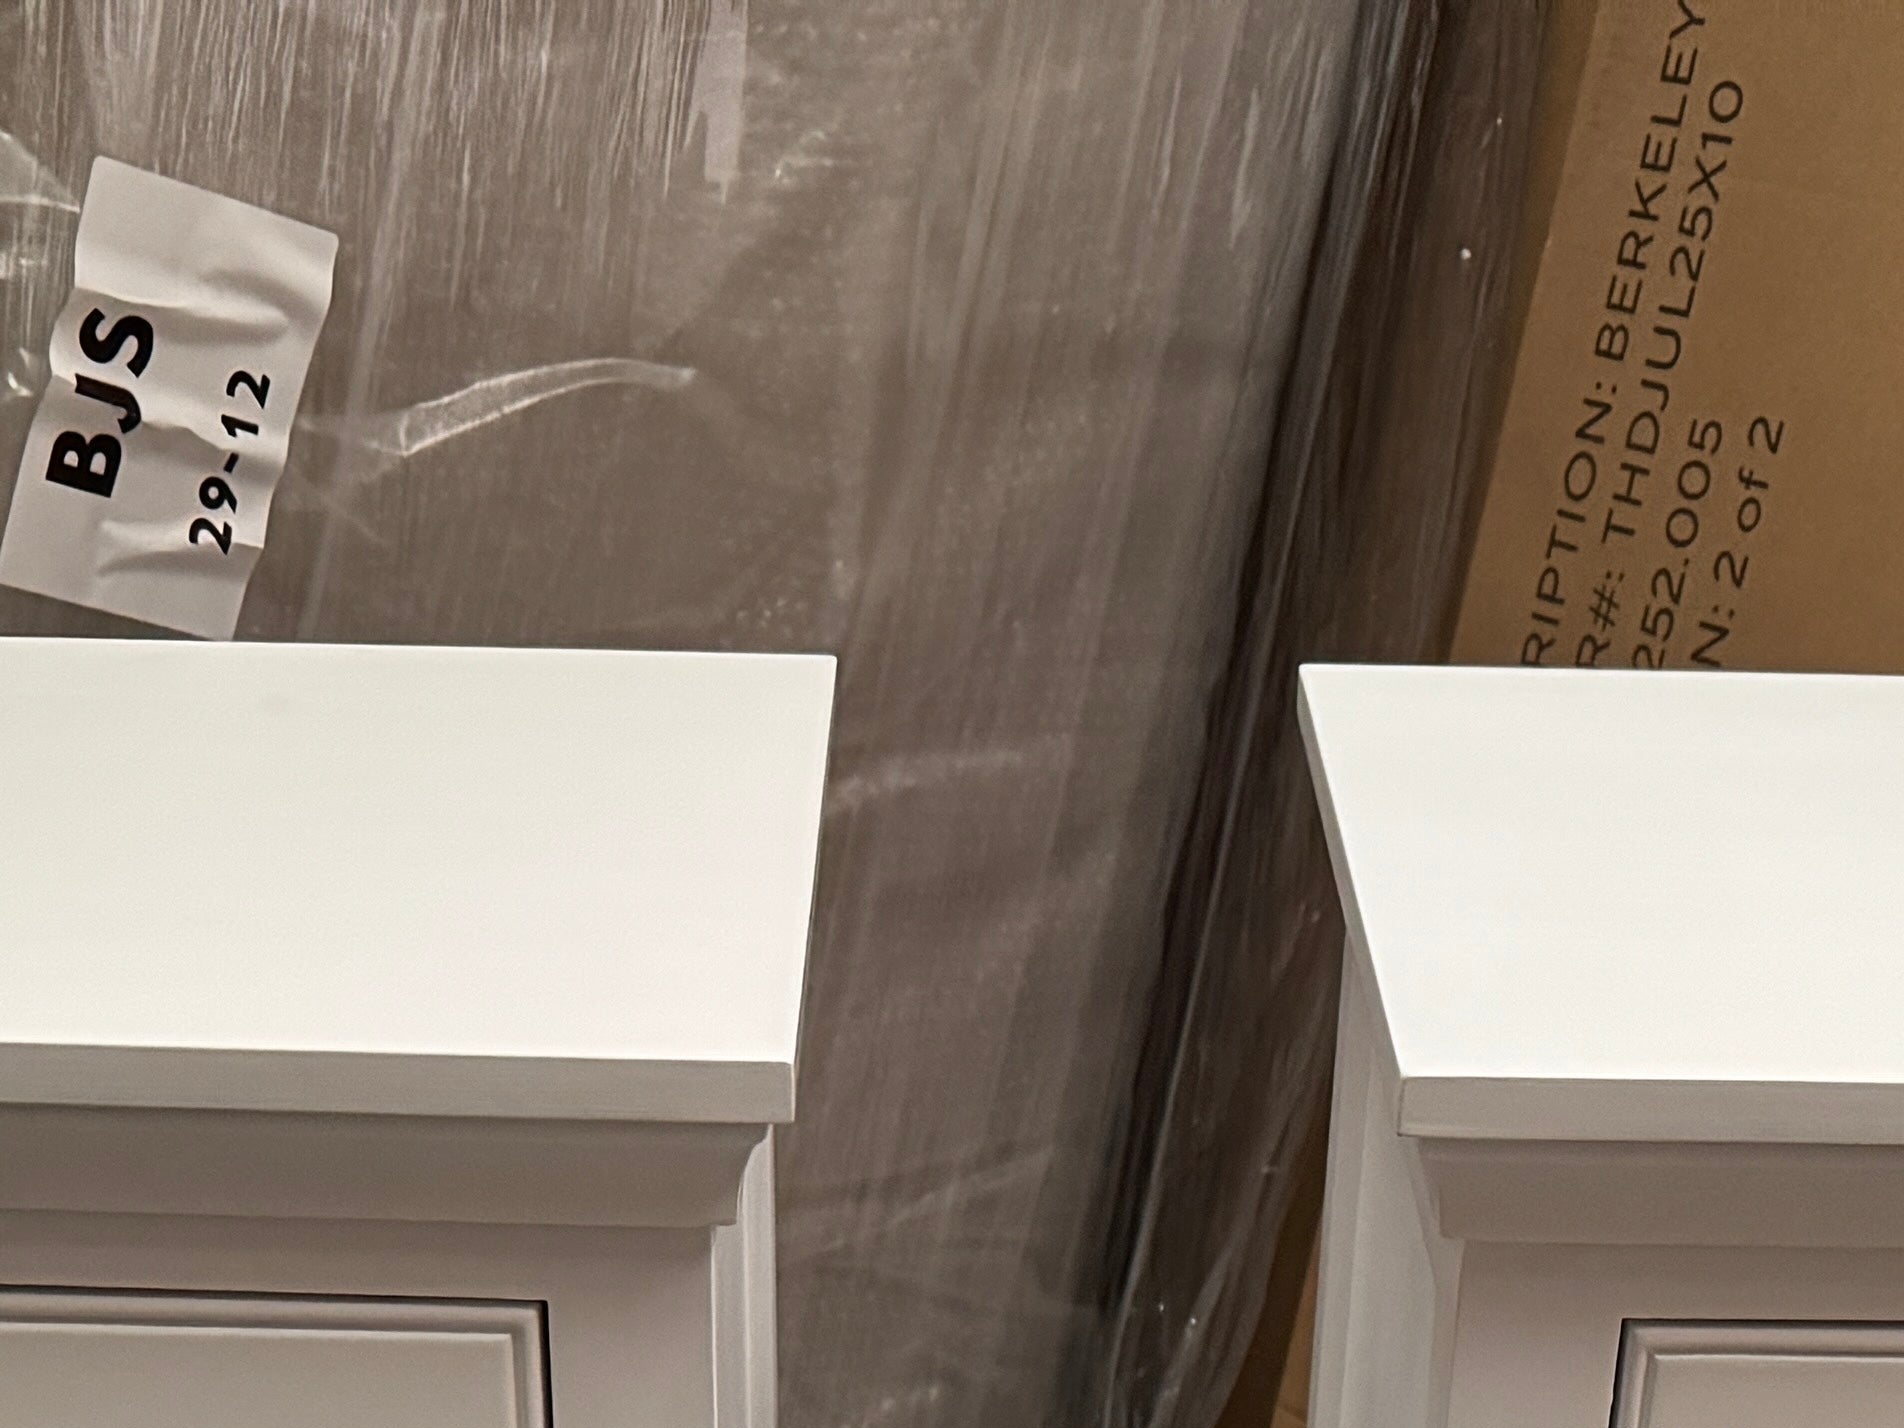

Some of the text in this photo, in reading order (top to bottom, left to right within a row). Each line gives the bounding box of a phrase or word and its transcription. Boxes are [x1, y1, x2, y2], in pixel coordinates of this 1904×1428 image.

[1595, 0, 1705, 361] BERKELEY
[45, 308, 154, 498] BJS
[1601, 80, 1744, 544] THDJUL25X10
[189, 370, 271, 555] 29-12
[1737, 466, 1769, 533] of
[1748, 416, 1784, 454] 2
[1713, 550, 1749, 588] 2
